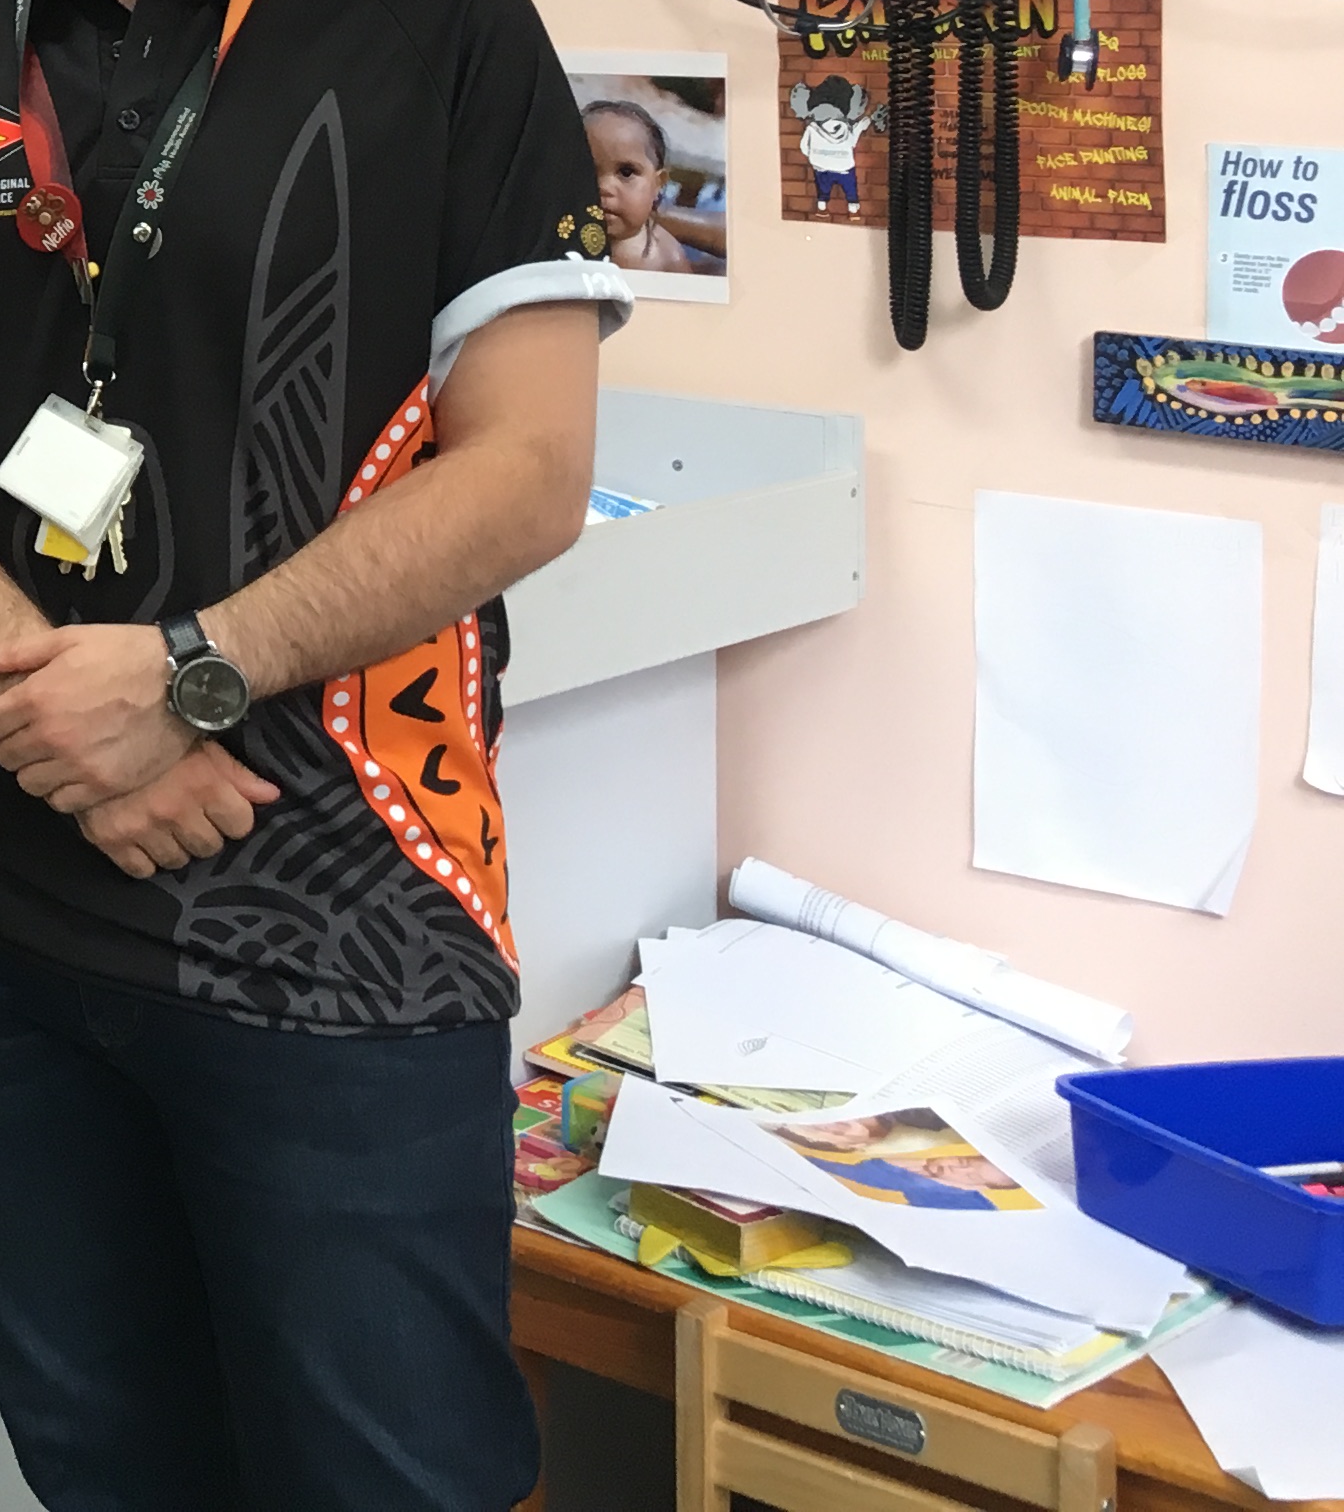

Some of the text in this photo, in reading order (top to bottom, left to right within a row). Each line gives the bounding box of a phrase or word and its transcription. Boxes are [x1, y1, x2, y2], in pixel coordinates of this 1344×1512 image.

[1097, 64, 1147, 82] FLOSS
[1073, 109, 1152, 134] MACHINES!
[1036, 145, 1148, 169] FACE PAINTING
[1220, 150, 1319, 181] How to
[1050, 183, 1102, 204] ANIMAL
[1220, 179, 1318, 223] floss
[1220, 253, 1228, 263] 3
